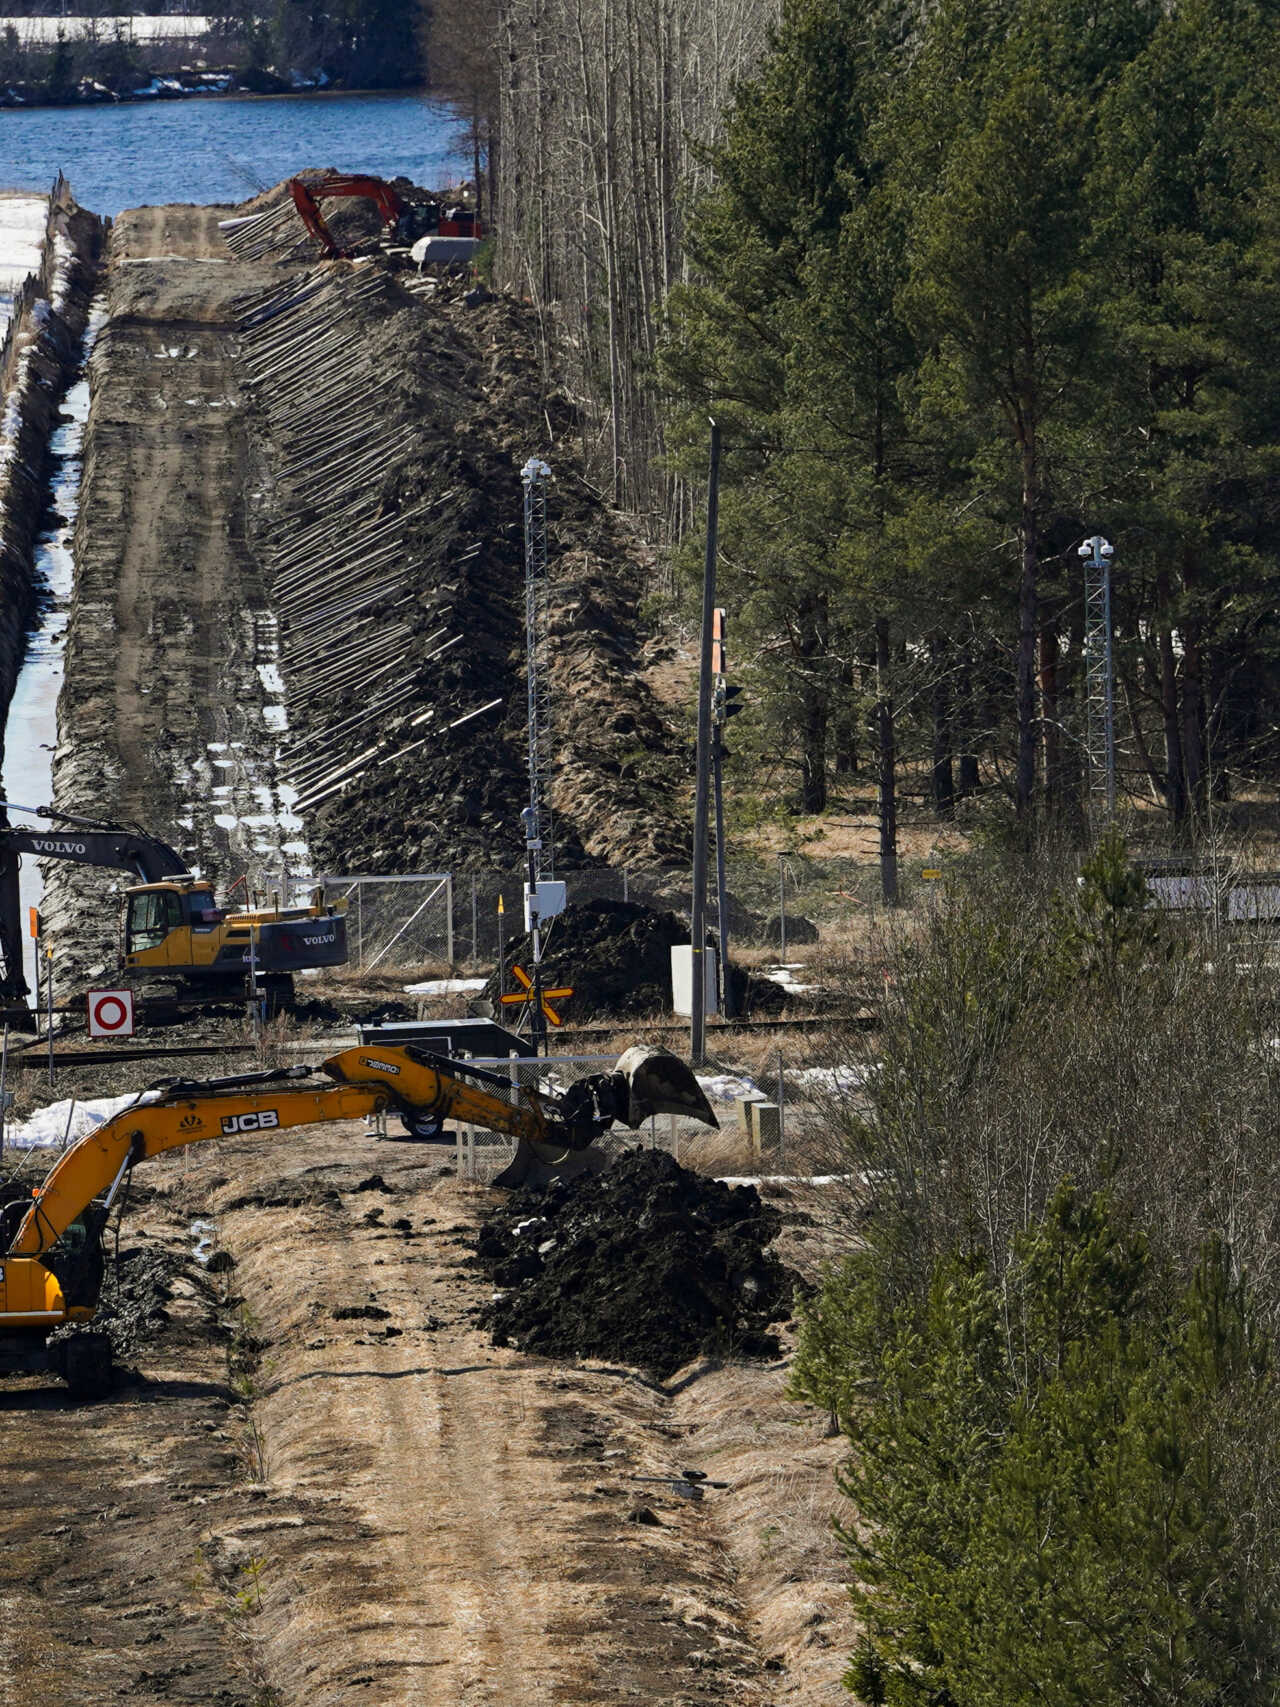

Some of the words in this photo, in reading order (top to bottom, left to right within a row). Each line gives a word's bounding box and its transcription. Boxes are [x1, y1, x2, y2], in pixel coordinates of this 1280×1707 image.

[31, 839, 86, 854] VOLVO
[303, 934, 335, 945] VOLVO
[223, 1111, 278, 1134] JCB
